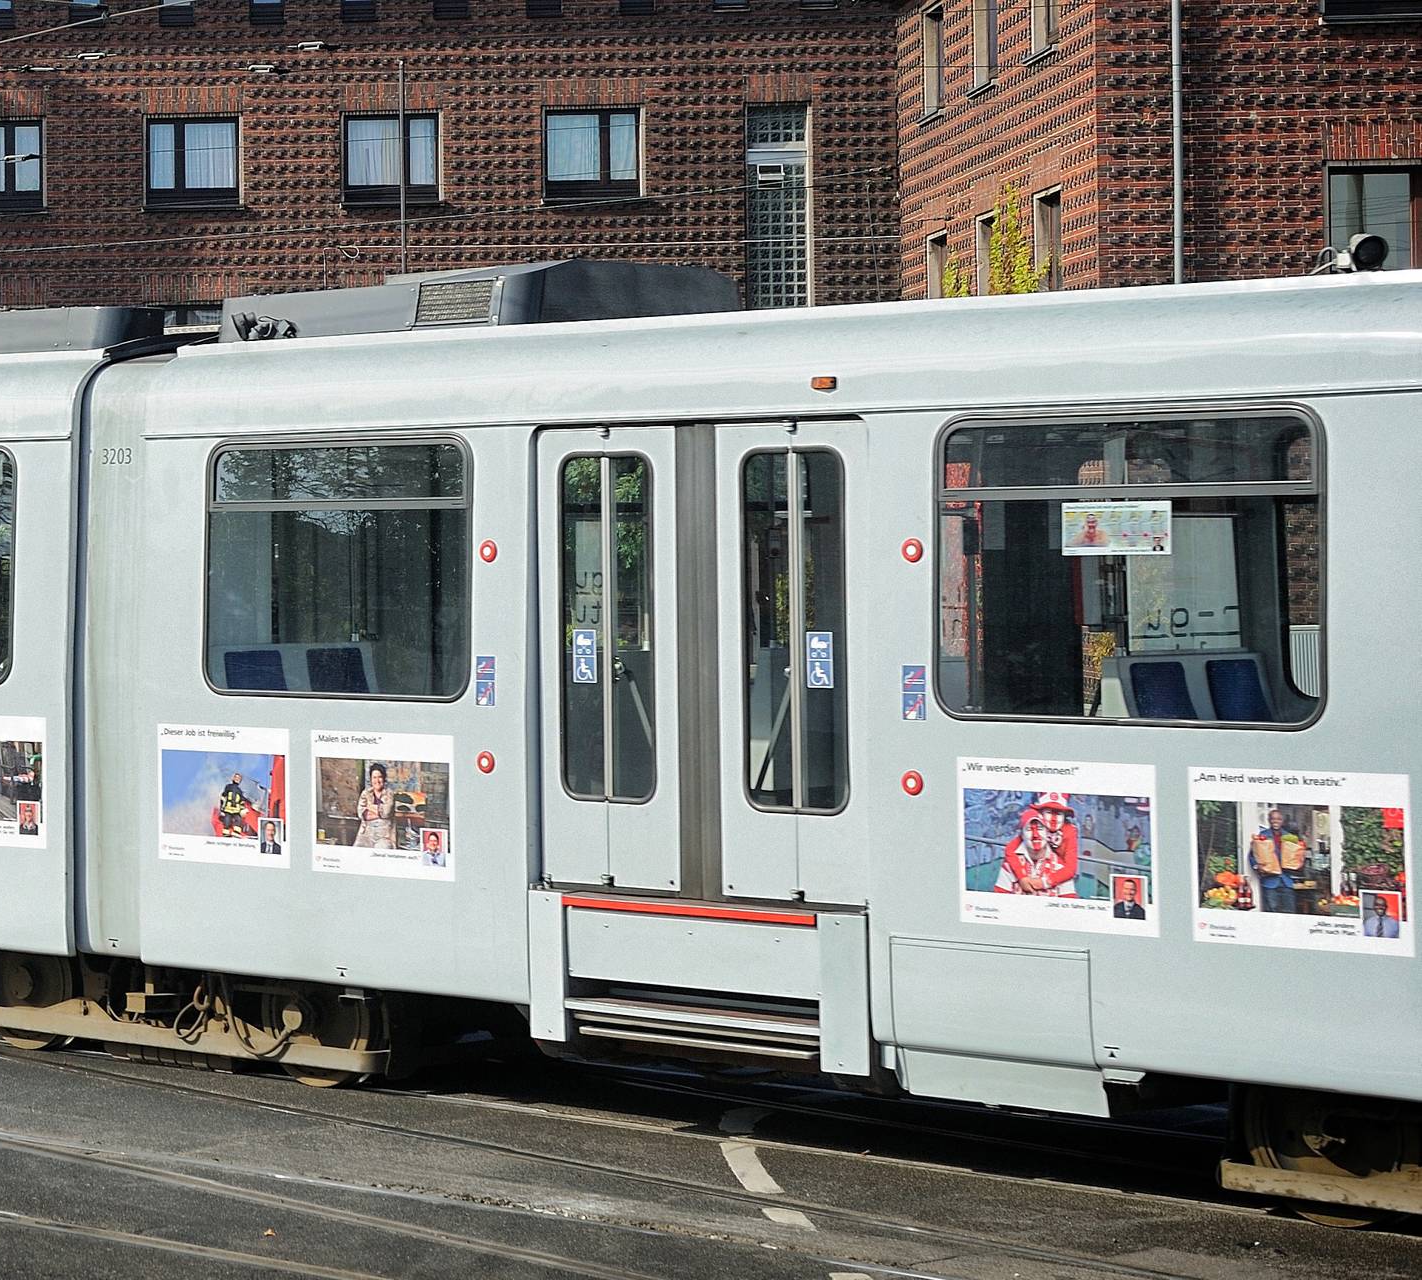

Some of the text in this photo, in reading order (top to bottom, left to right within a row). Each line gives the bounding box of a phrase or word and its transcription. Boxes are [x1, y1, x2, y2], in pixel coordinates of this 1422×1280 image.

[102, 448, 132, 465] 3203
[986, 763, 1021, 773] werden
[1219, 773, 1244, 783] Herd
[1247, 774, 1280, 784] werde
[1283, 775, 1299, 785] ich
